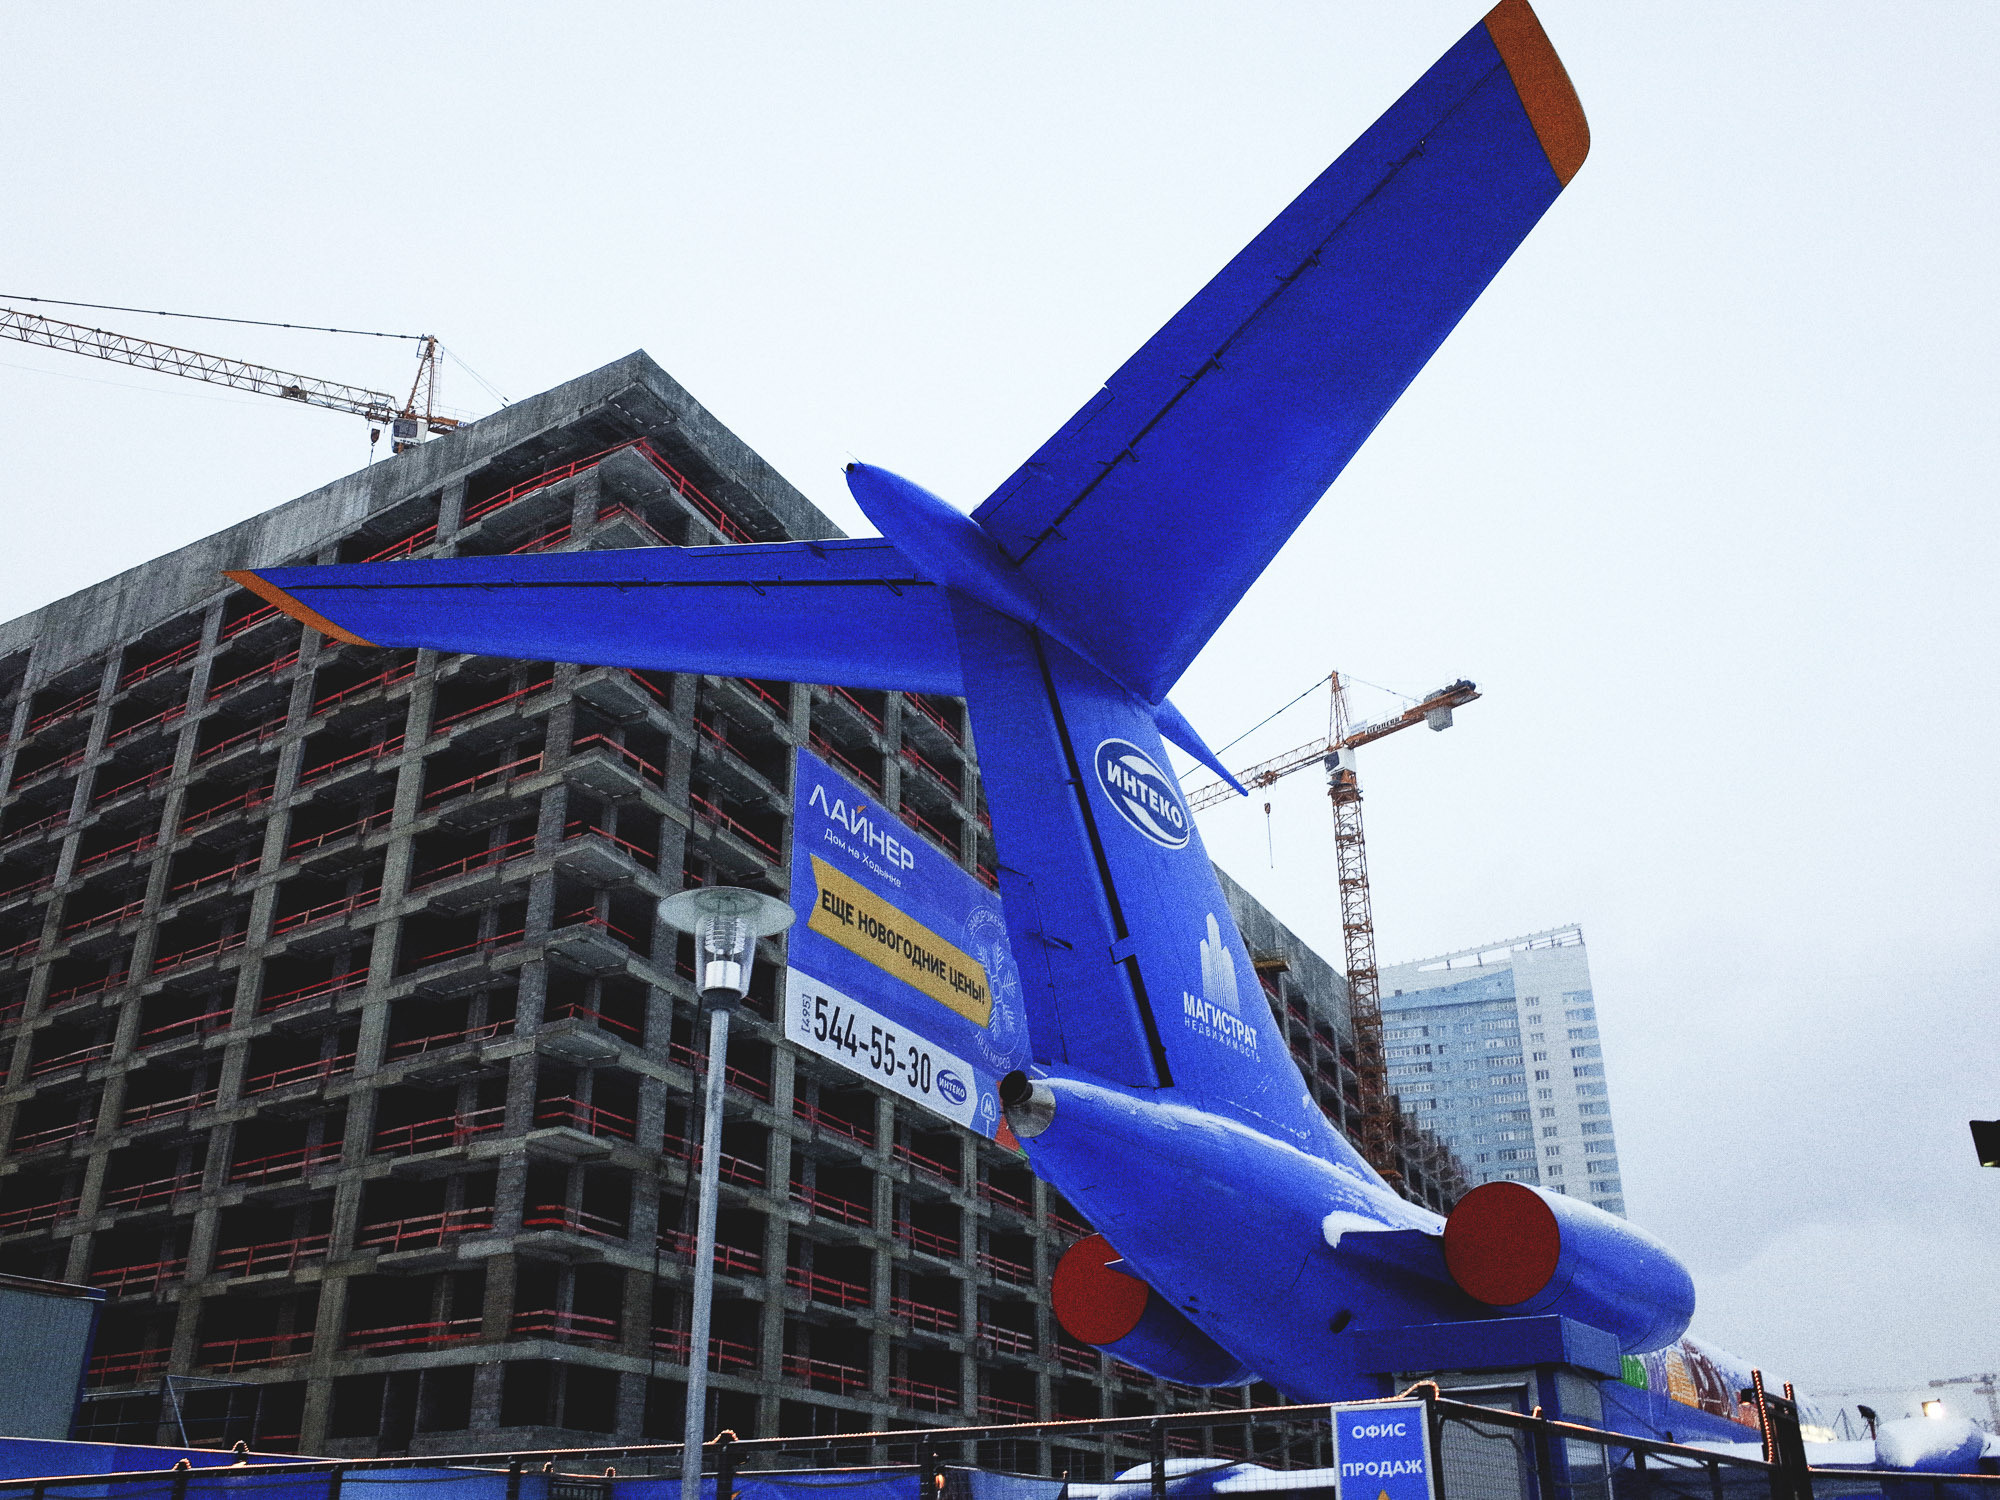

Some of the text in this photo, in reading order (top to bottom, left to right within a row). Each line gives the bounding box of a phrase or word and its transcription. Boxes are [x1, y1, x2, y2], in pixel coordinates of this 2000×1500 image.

[1106, 760, 1184, 829] ИНТЕКО
[808, 784, 914, 870] ЛАЙНЕР
[824, 828, 902, 888] Дом на Ходынке
[821, 888, 985, 1005] ЕЩЕ НОВОГОДНИЕ ЦЕНЫ!
[814, 995, 931, 1094] 544-55-30
[1183, 991, 1257, 1050] МАГИСТРАТ
[1184, 1016, 1261, 1063] НЕДВИЖИМОСТЬ
[939, 1077, 966, 1098] ИНТЕКО
[1352, 1423, 1407, 1439] ОФИС
[1342, 1459, 1423, 1478] ПРОДАЖ
